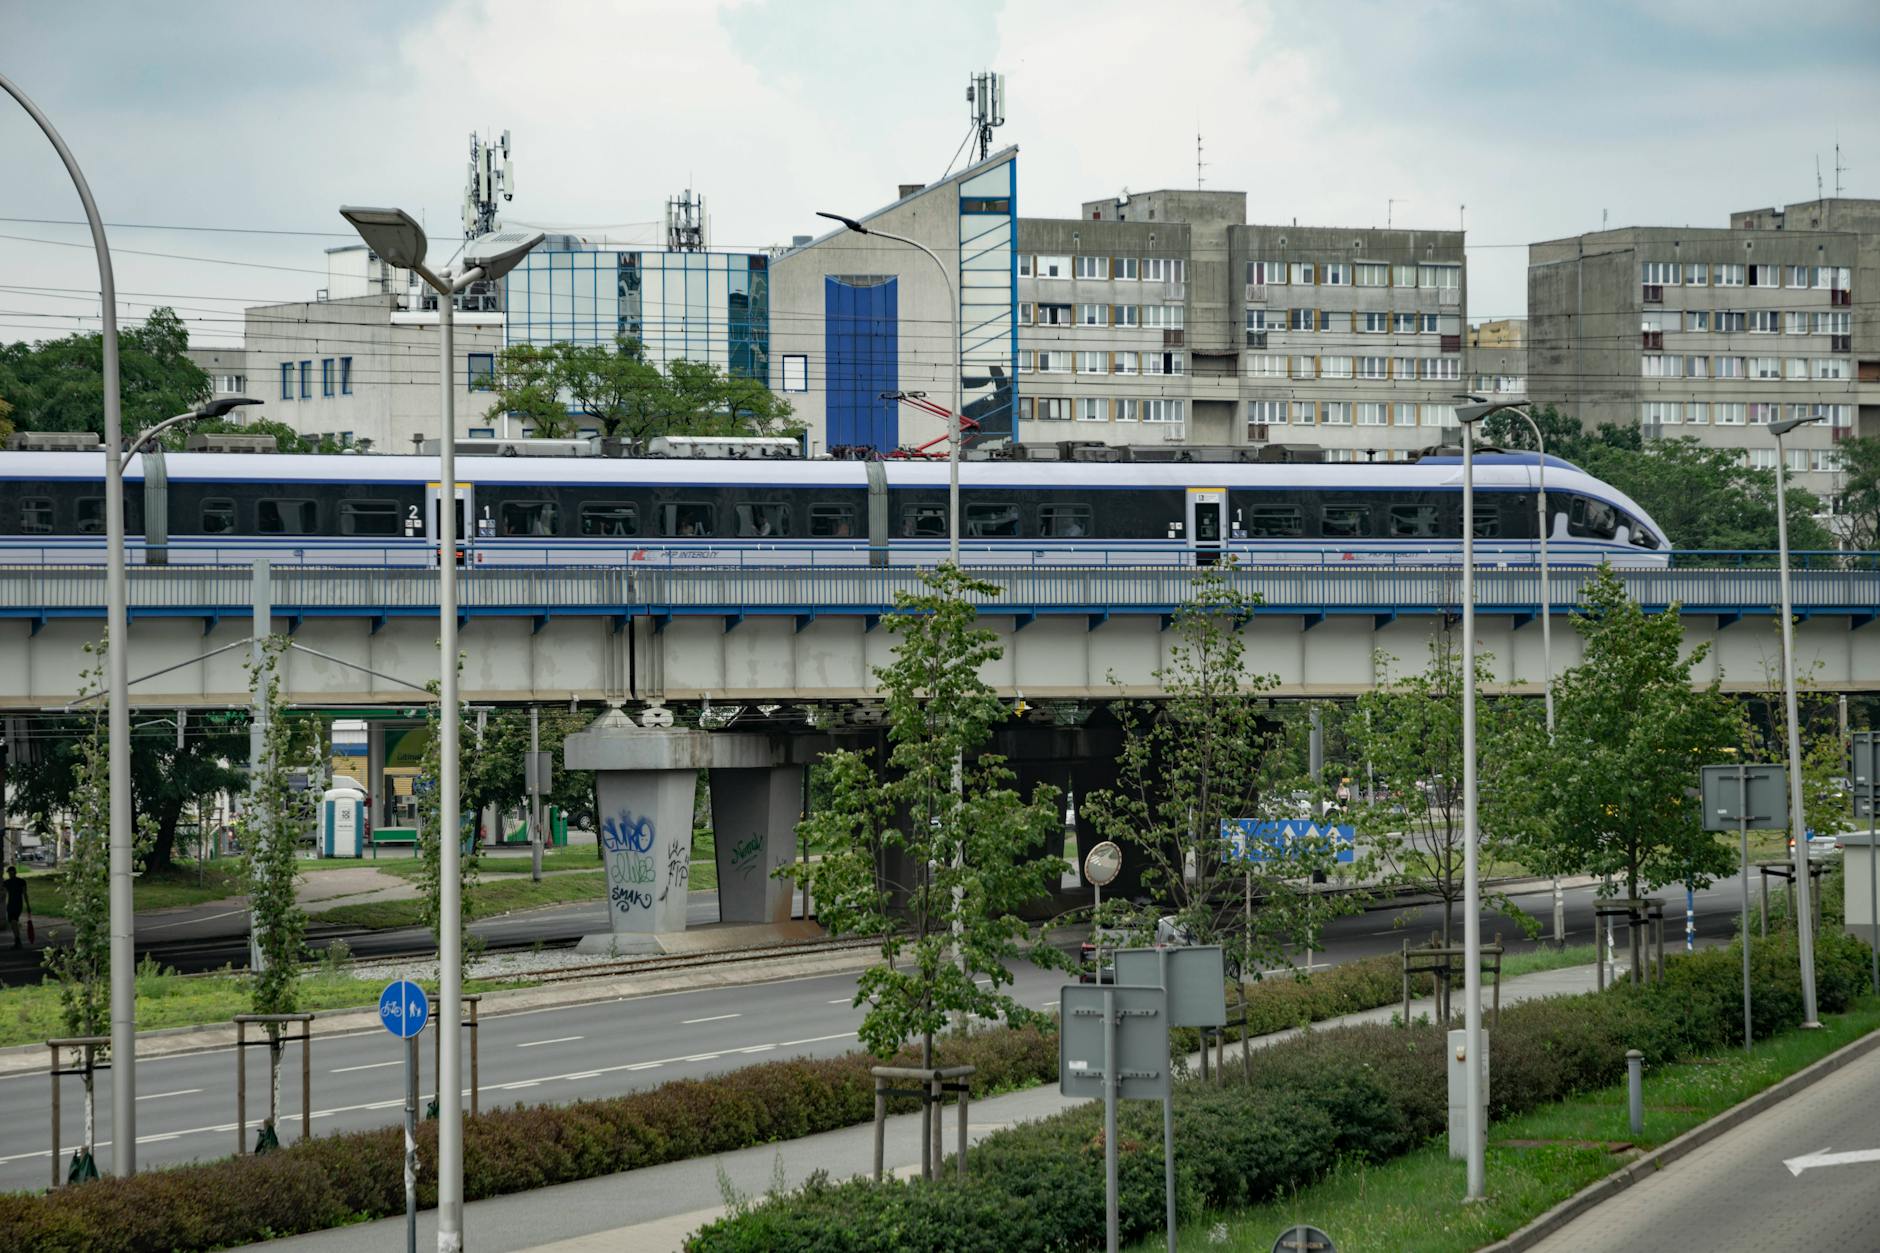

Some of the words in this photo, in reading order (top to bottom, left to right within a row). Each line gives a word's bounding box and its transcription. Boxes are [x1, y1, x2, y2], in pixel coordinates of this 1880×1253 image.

[408, 505, 418, 519] 2
[484, 505, 490, 519] 1
[1237, 508, 1242, 522] 1
